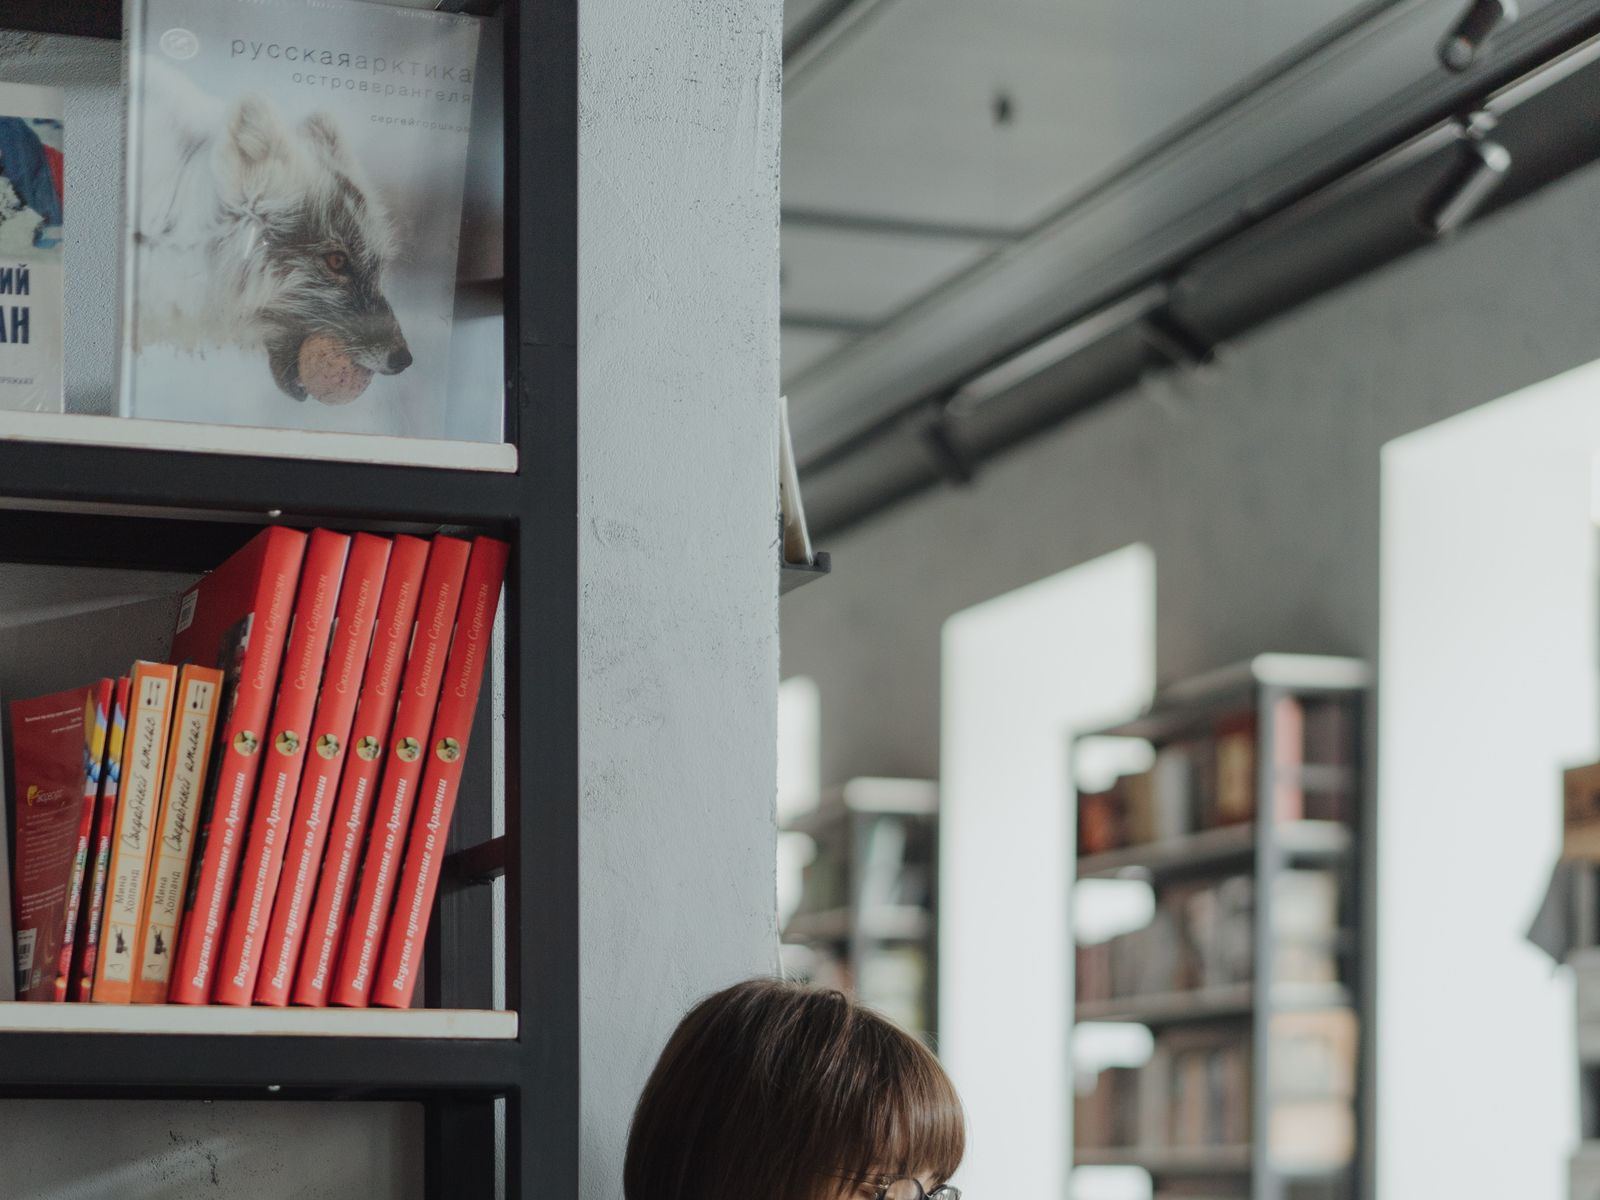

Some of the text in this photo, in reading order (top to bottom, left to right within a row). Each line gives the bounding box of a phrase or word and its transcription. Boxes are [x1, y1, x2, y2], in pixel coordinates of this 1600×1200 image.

[253, 573, 286, 690] Сюзанна Саркисян
[295, 574, 328, 690] Сюзанна Саркисян
[336, 578, 370, 694] Сюзанна Саркисян
[376, 581, 410, 697] Сюзанна Саркисян
[416, 582, 449, 697] Сюзанна Саркисян
[456, 583, 488, 698] Сюзанна Саркисян
[115, 875, 127, 904] Мина
[124, 869, 141, 913] Холланд
[155, 876, 168, 905] Мина
[164, 871, 182, 915] Холланд
[192, 772, 246, 989] Вкусное путешествие по Армении
[233, 772, 287, 988] Вкусное путешествие по Армении
[271, 775, 327, 989] Вкусное путешествие по Армении
[311, 777, 368, 991] Вкусное путешествие по Армении
[352, 778, 408, 991] Вкусное путешествие по Армении
[393, 778, 448, 991] Вкусное путешествие по Армении
